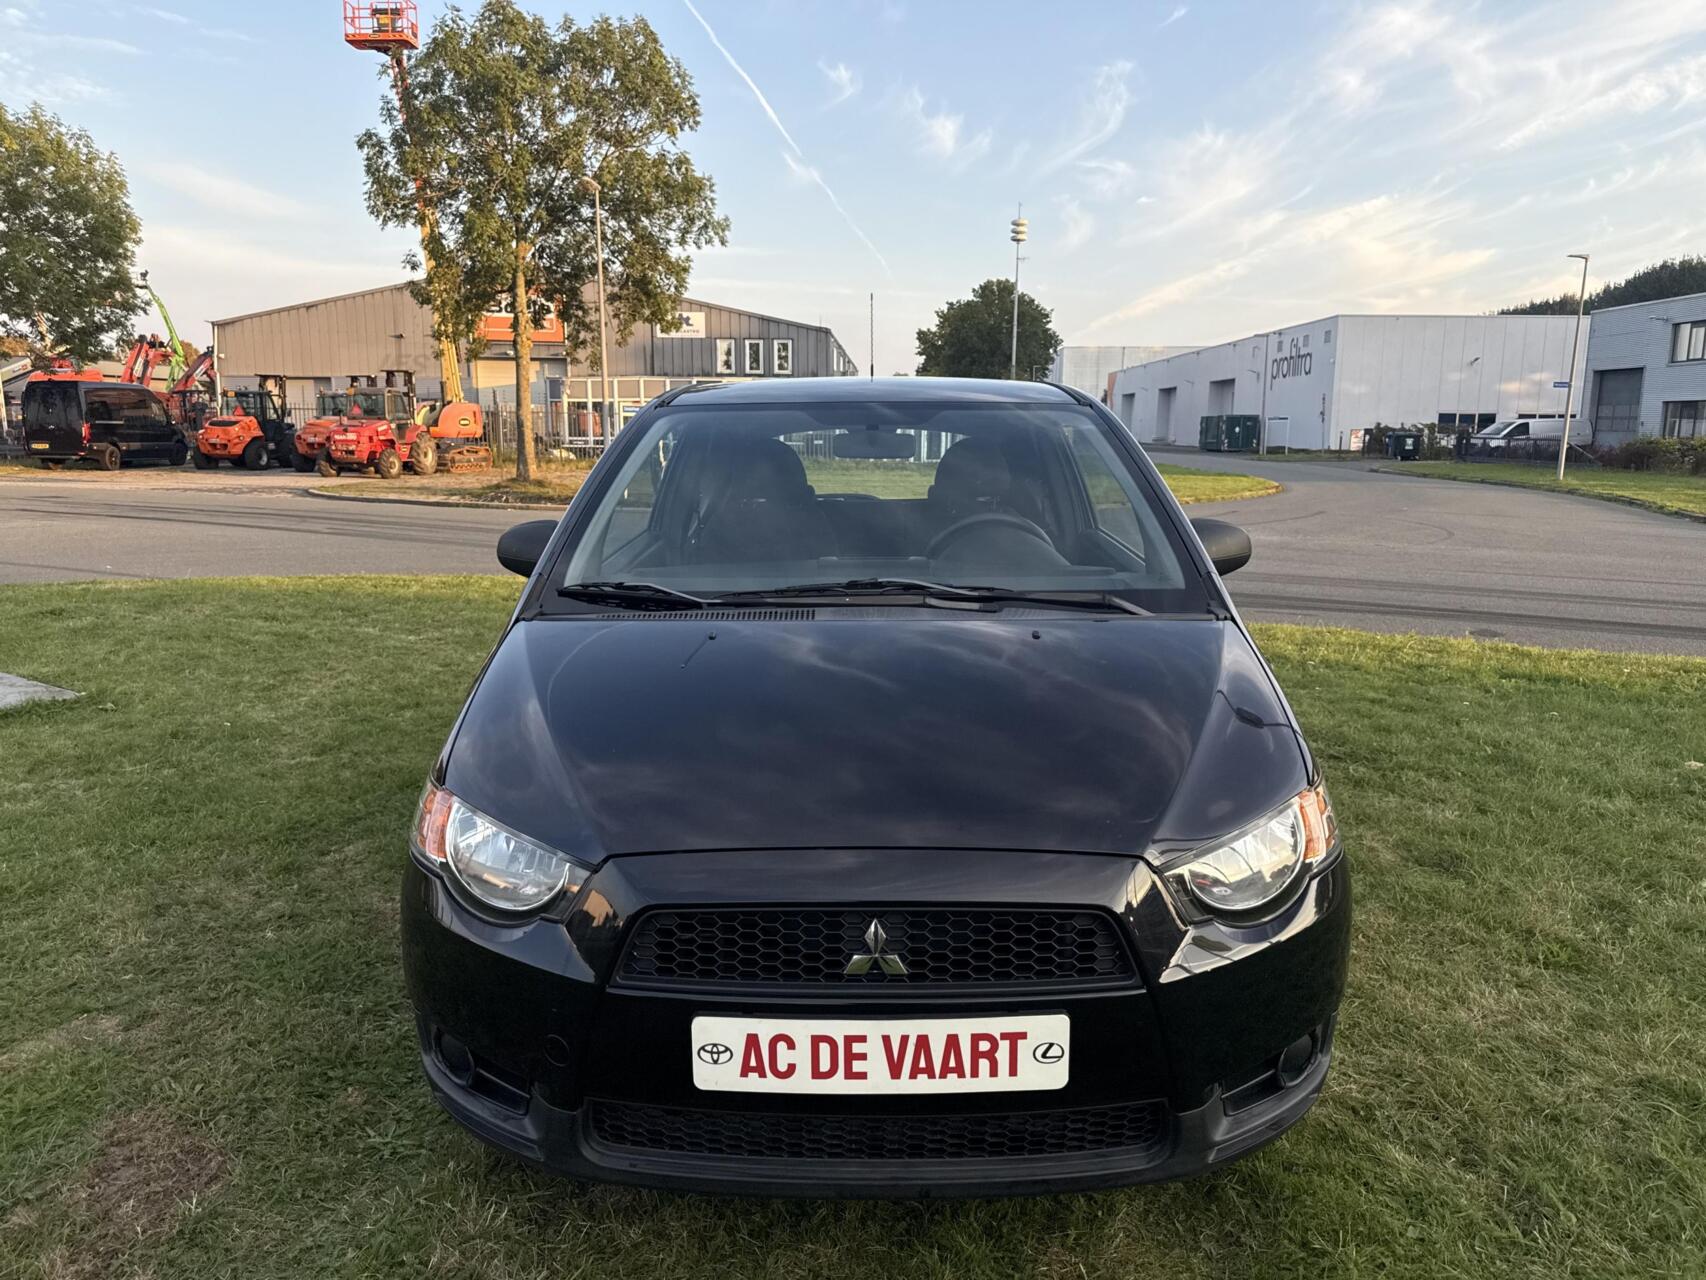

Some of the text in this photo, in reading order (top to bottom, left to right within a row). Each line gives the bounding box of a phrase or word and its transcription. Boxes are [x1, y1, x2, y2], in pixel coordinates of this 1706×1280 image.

[1270, 336, 1313, 391] profiltra
[739, 1031, 1028, 1081] AC DE VAART
